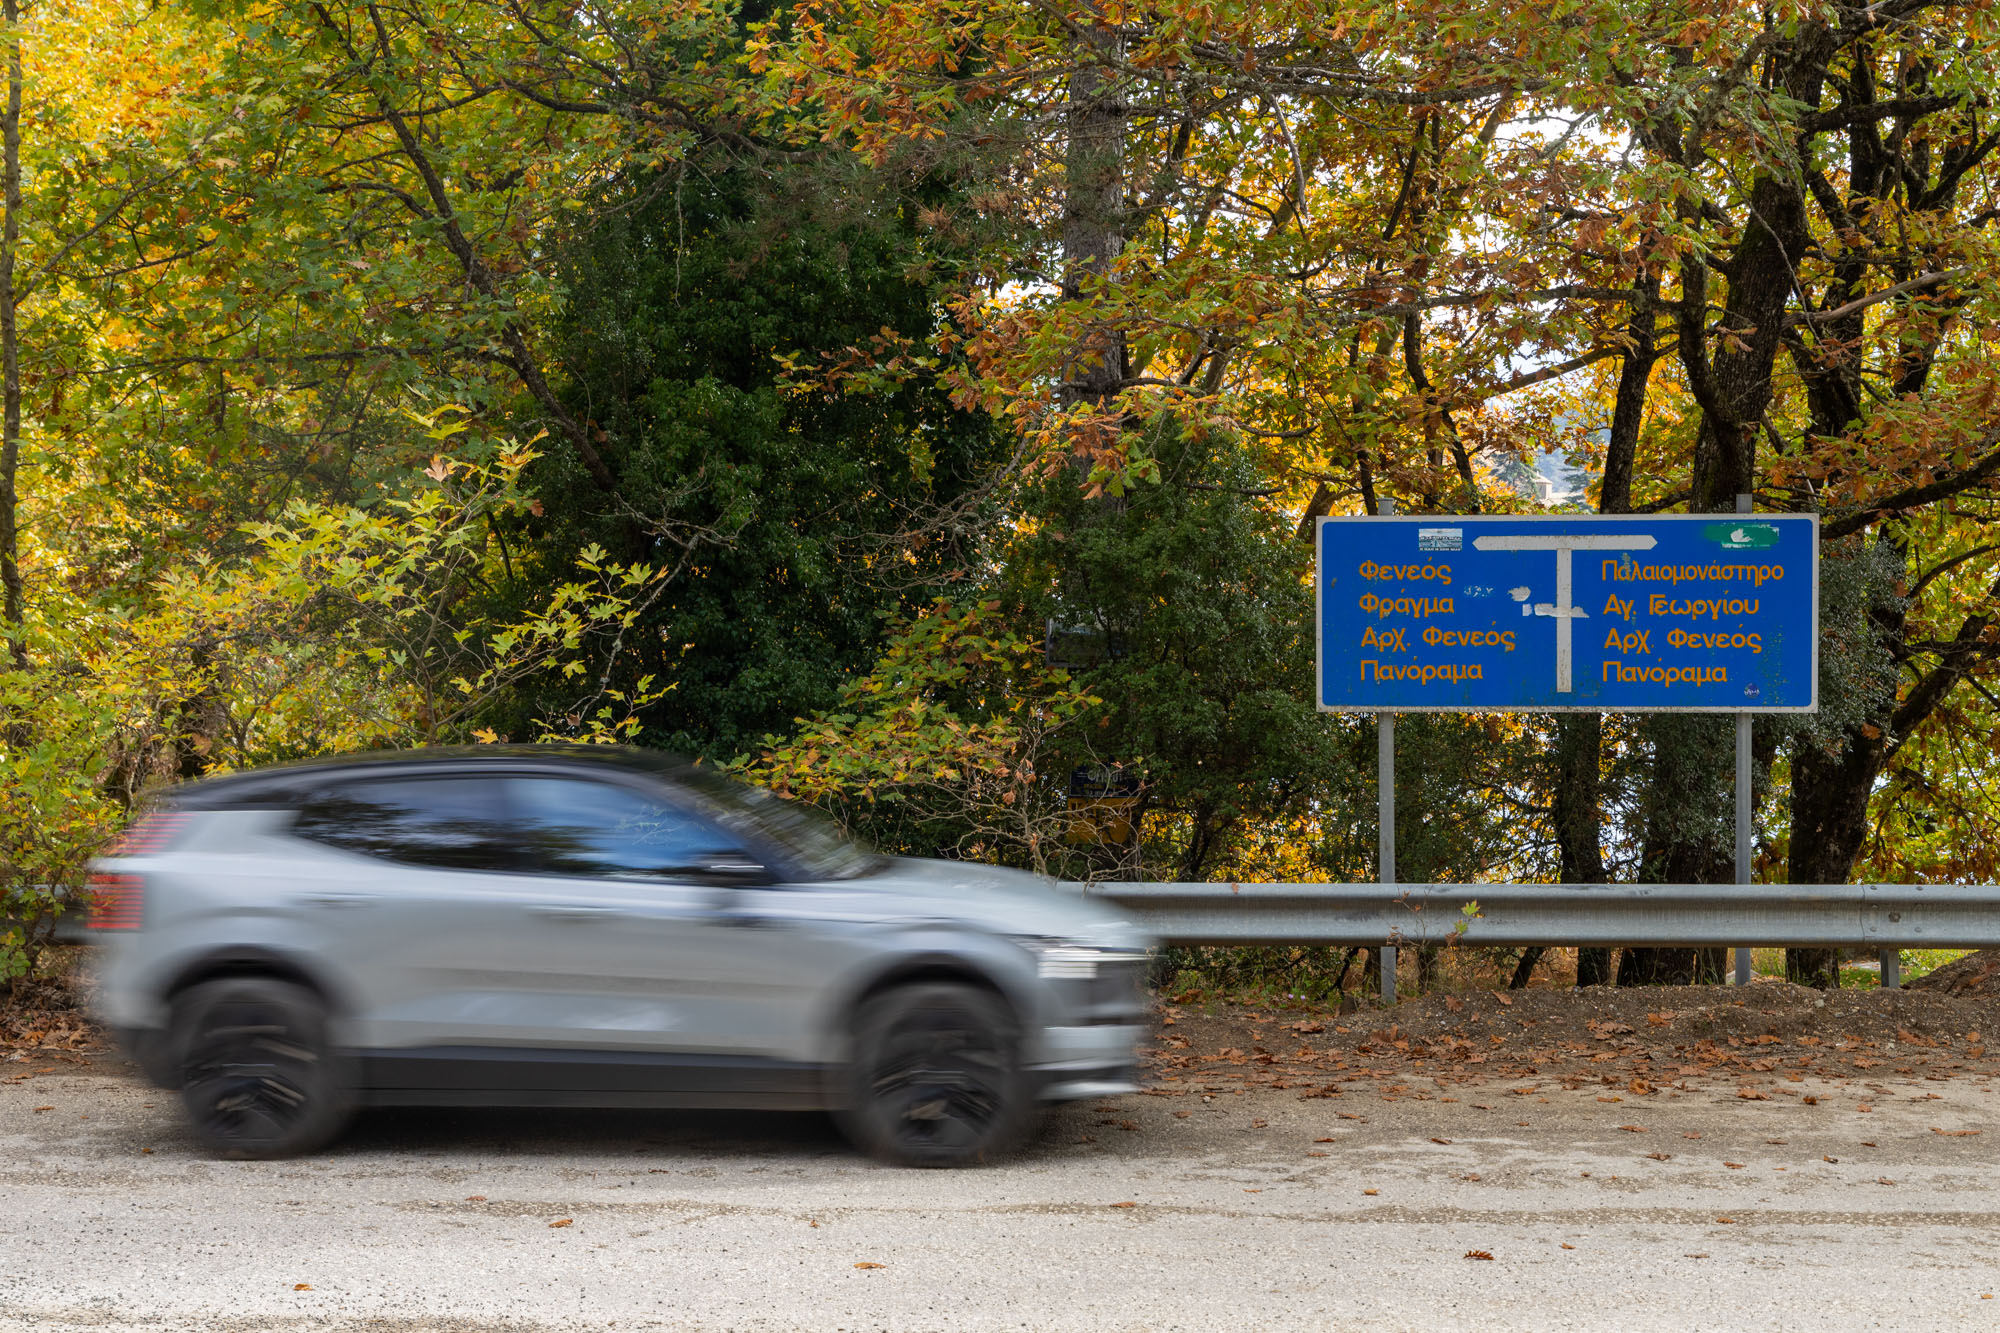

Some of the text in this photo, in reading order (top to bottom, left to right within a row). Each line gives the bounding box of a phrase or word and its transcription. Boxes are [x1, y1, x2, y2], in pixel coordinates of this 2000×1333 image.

[1359, 557, 1452, 585] Φενεός
[1602, 560, 1785, 587] Παλαιομονάστηρο
[1359, 588, 1455, 619] Φράγμα
[1603, 590, 1760, 621] Αγ. Γεωργίου
[1422, 621, 1516, 653] Φενεός
[1667, 624, 1763, 654] Φενεός
[1360, 656, 1484, 686] Πανόραμα
[1603, 658, 1728, 688] Πανόραμα
